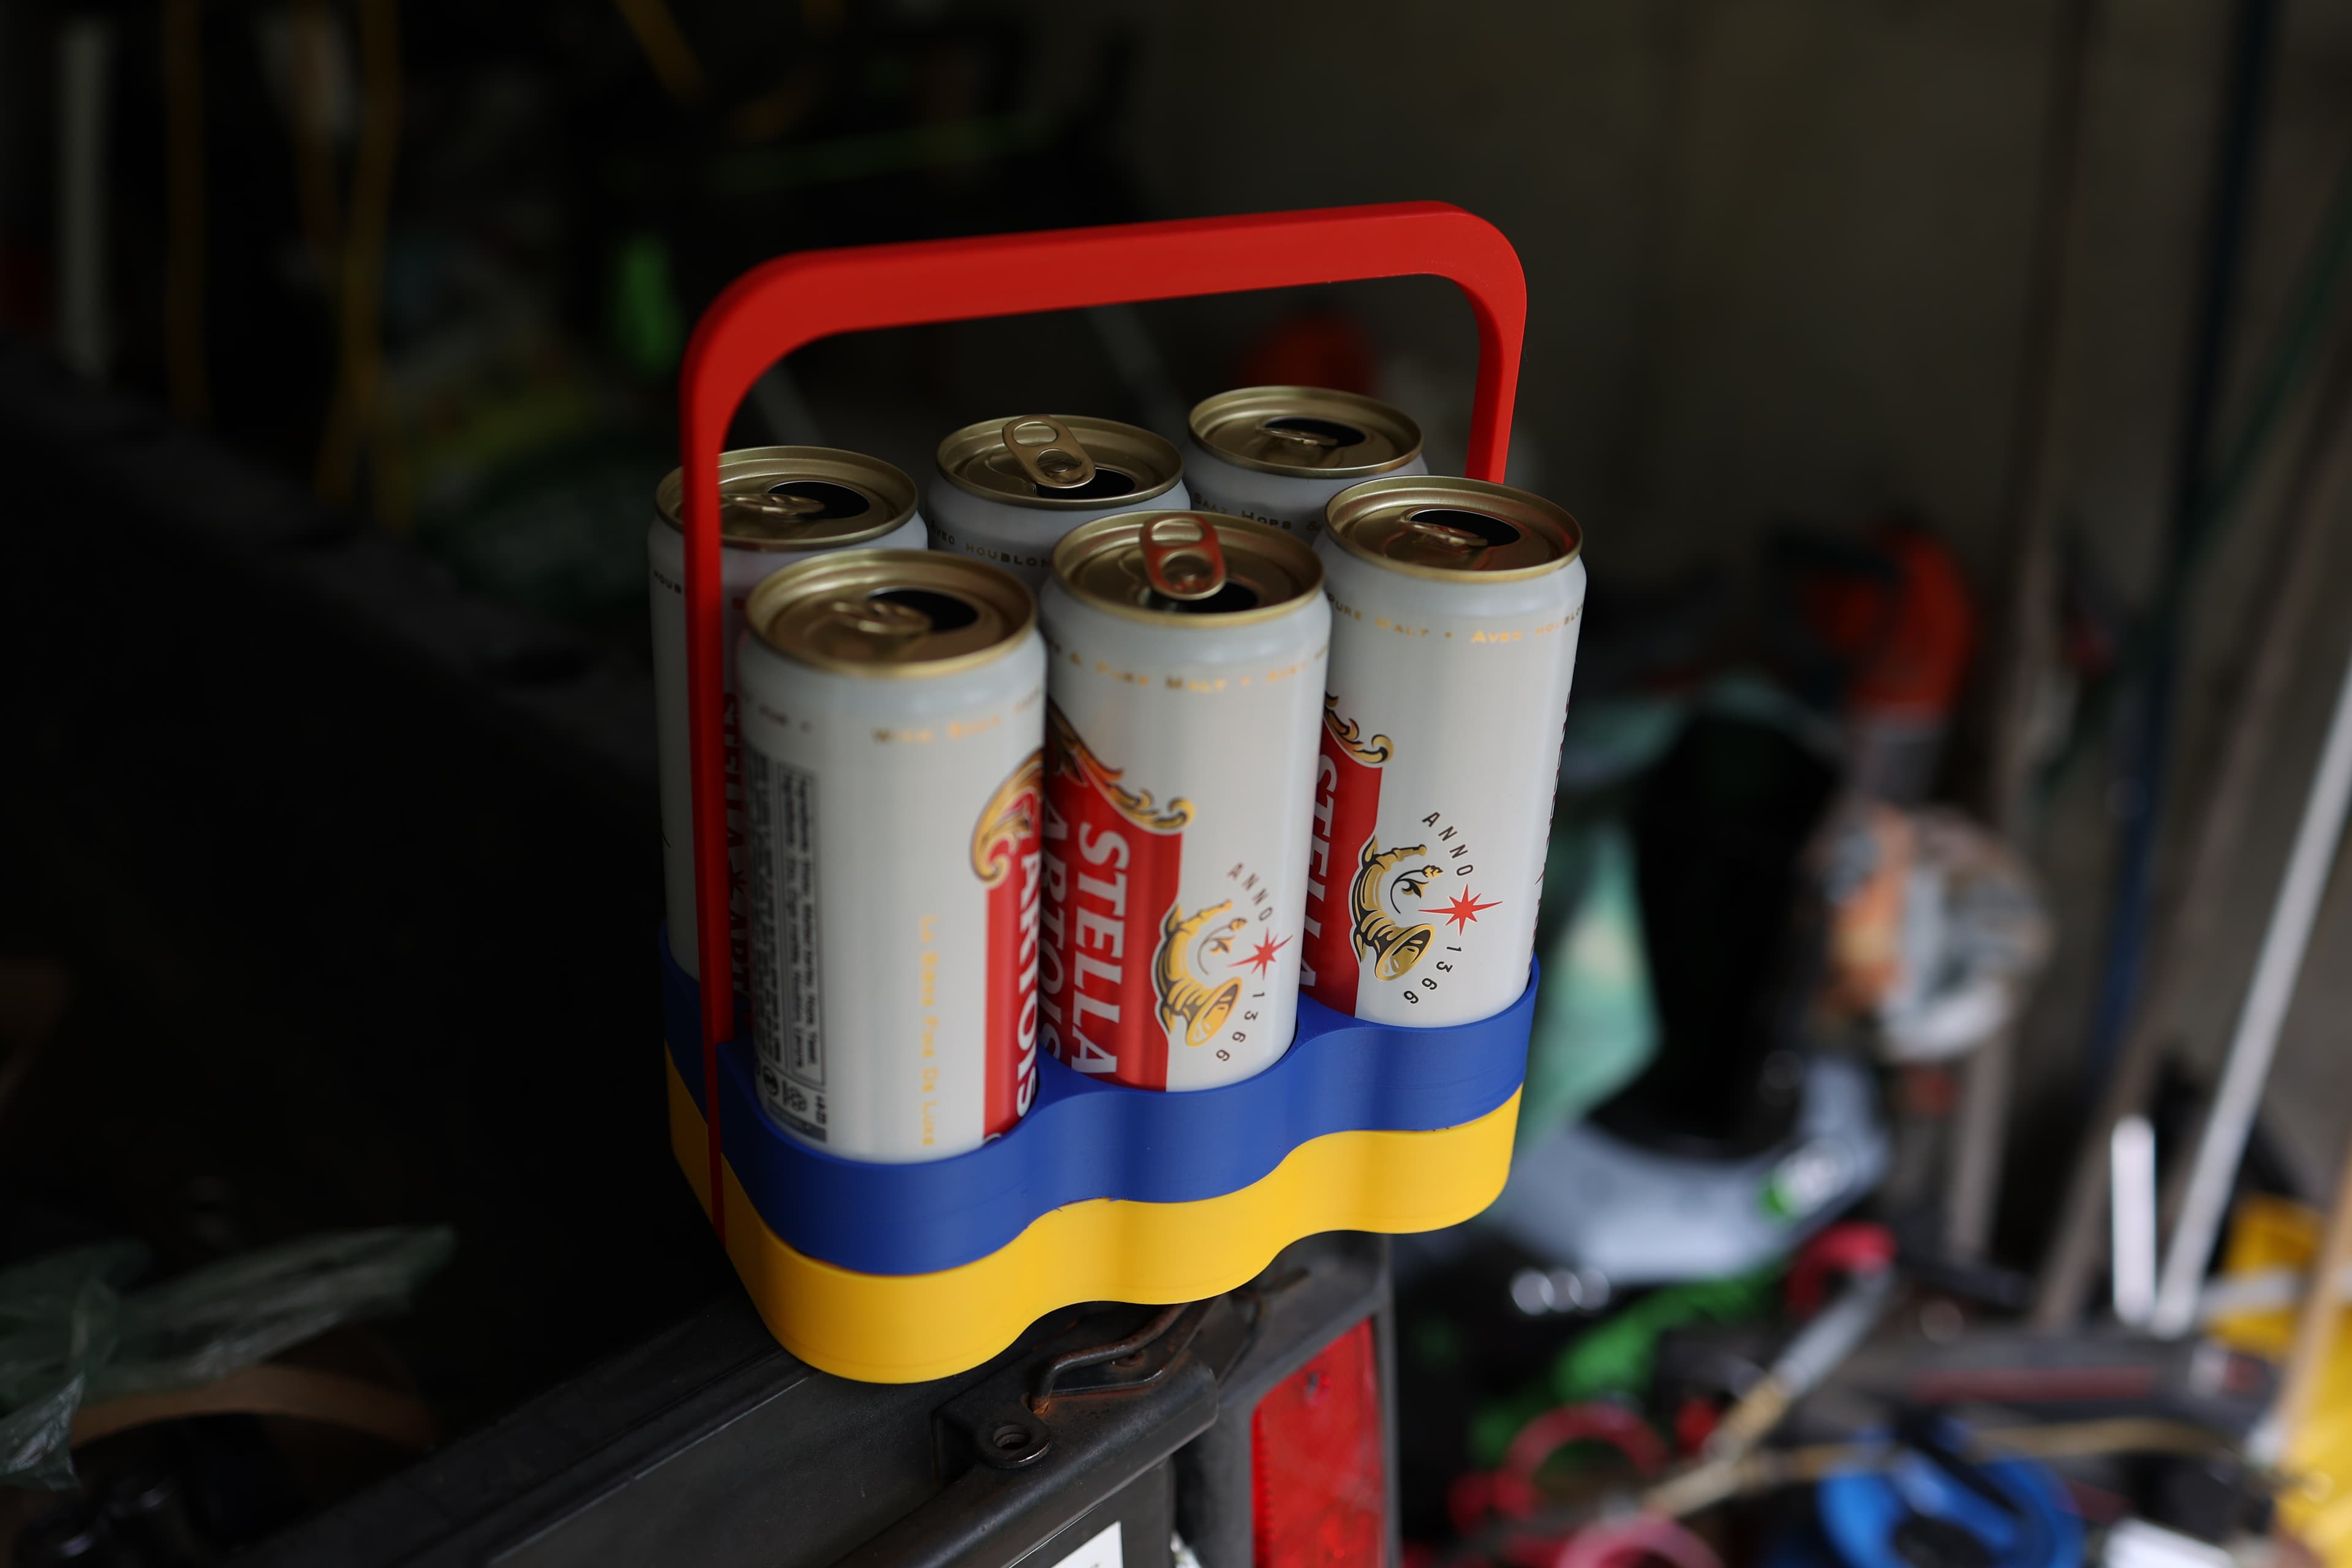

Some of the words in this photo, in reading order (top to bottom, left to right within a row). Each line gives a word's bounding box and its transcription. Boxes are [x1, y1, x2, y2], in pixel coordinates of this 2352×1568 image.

[1301, 754, 1338, 987] STELLA
[1422, 812, 1474, 877] ANNO
[1227, 862, 1274, 922] ANNO
[1071, 821, 1131, 1074] STELLA
[1403, 945, 1463, 1005] 1366
[1215, 990, 1265, 1062] 1366
